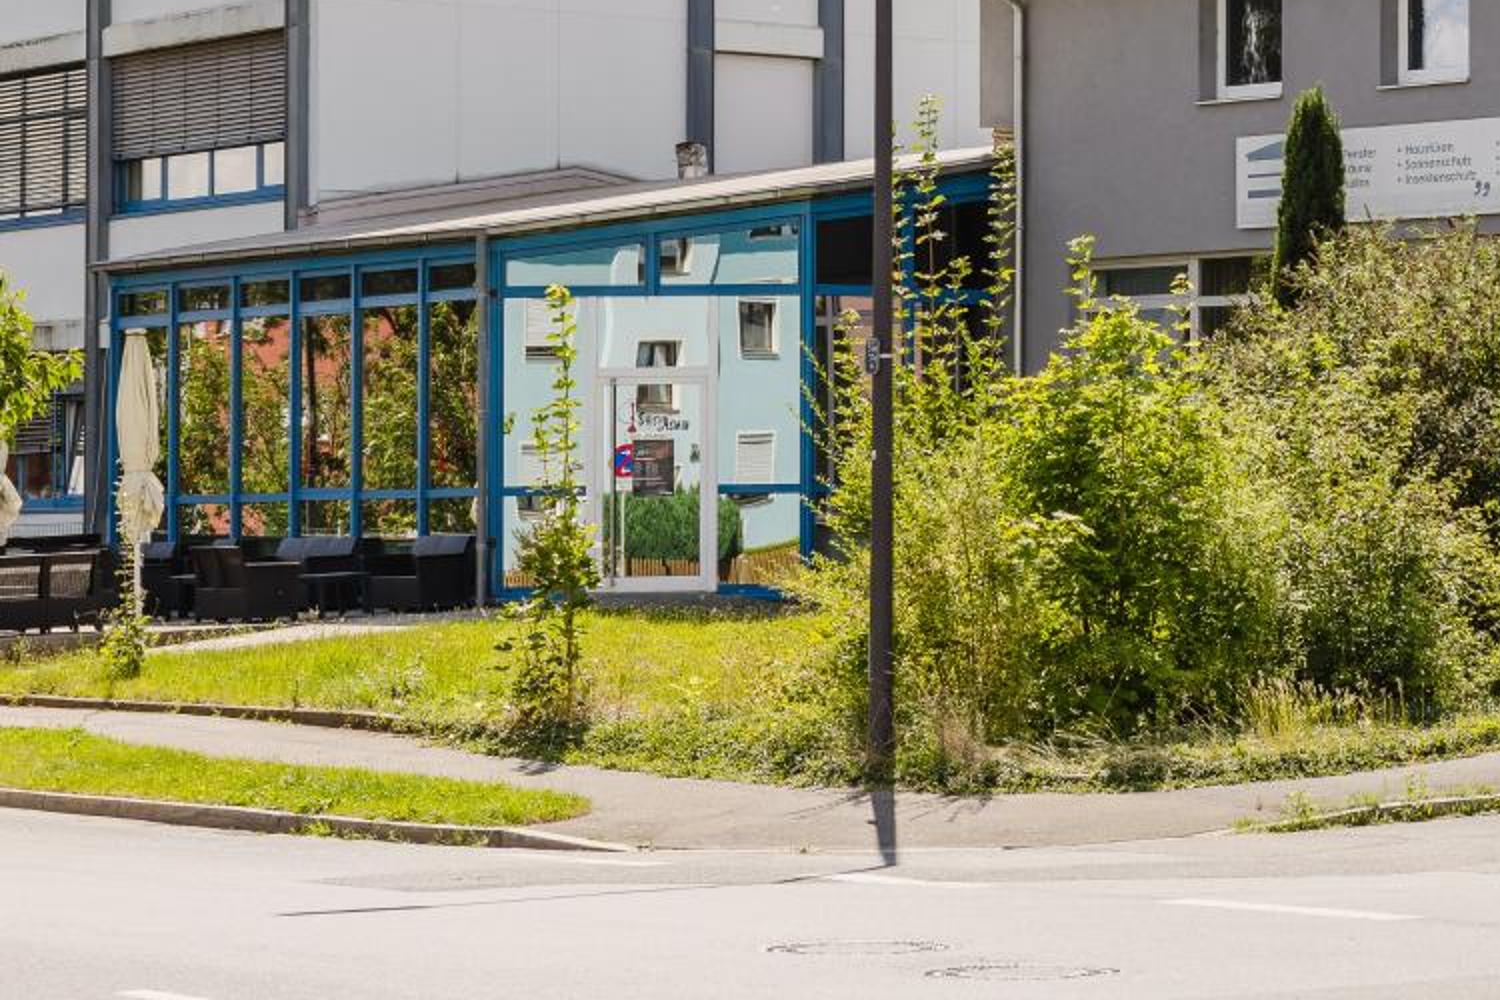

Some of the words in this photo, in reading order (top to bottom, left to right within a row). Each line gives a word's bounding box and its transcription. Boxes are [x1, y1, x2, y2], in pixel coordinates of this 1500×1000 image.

[1344, 148, 1376, 159] enster
[1405, 154, 1472, 169] Sonnenschutz
[1405, 168, 1477, 182] Insektenschutz
